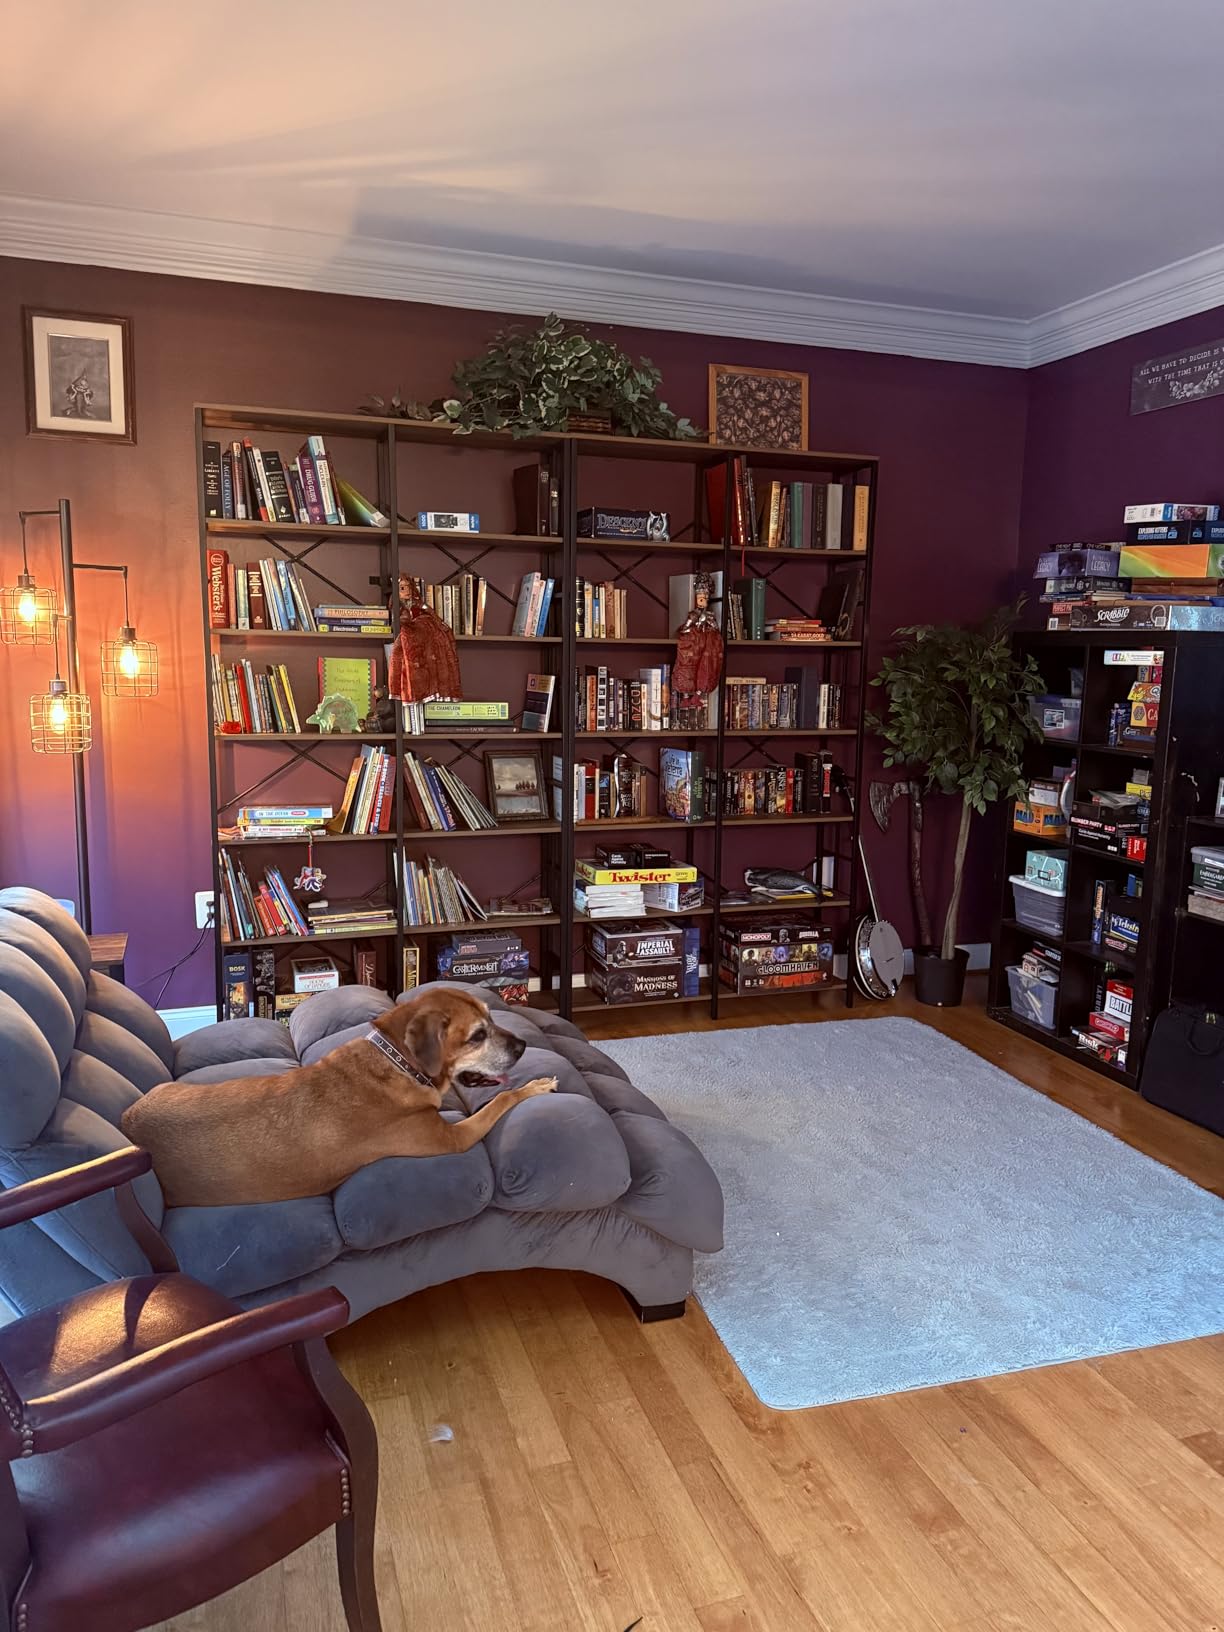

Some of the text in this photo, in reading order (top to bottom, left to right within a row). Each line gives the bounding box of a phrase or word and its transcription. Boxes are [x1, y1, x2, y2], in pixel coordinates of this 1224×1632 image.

[1162, 361, 1177, 370] HAVE
[1189, 350, 1210, 362] DECIDE
[1148, 376, 1162, 384] WITH
[1178, 368, 1192, 376] TIME
[1194, 363, 1210, 372] THAT
[224, 477, 230, 486] OF
[596, 514, 647, 529] DESCENT
[1091, 560, 1110, 572] LEGACY
[212, 566, 222, 613] Webster's
[1094, 606, 1130, 622] SCRABBLE
[609, 871, 671, 882] Twister
[636, 940, 674, 954] IMPERIAL
[757, 963, 819, 975] GLOOMHAVEN
[634, 981, 678, 992] MADNESS
